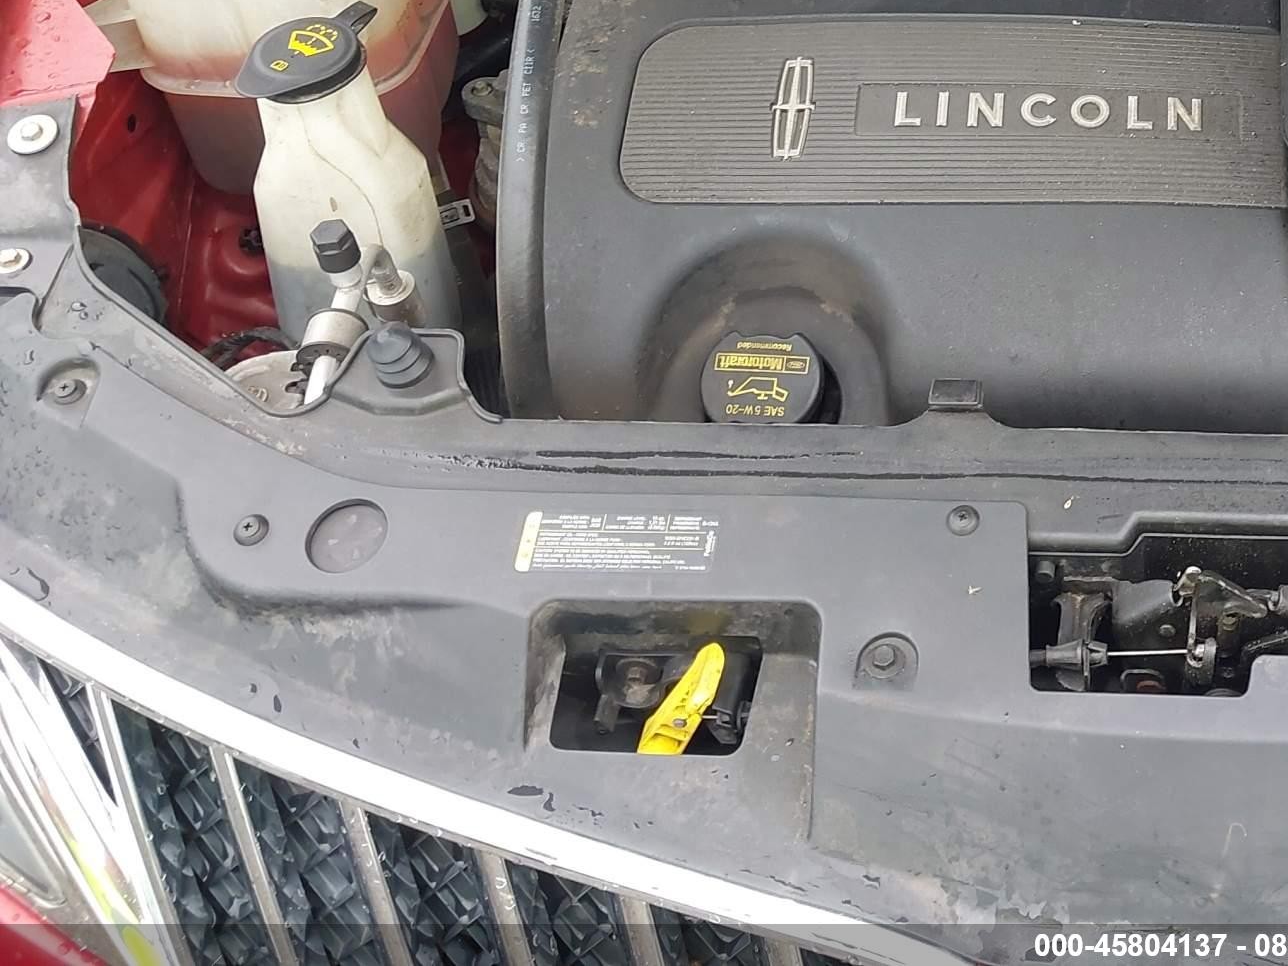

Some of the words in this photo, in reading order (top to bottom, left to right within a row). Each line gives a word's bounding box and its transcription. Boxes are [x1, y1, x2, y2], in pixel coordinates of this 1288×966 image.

[894, 91, 1203, 132] LINCOLN
[736, 341, 793, 352] Recommended
[719, 355, 784, 371] Motorcraft
[725, 403, 761, 416] 5W-20
[764, 405, 785, 417] SAE
